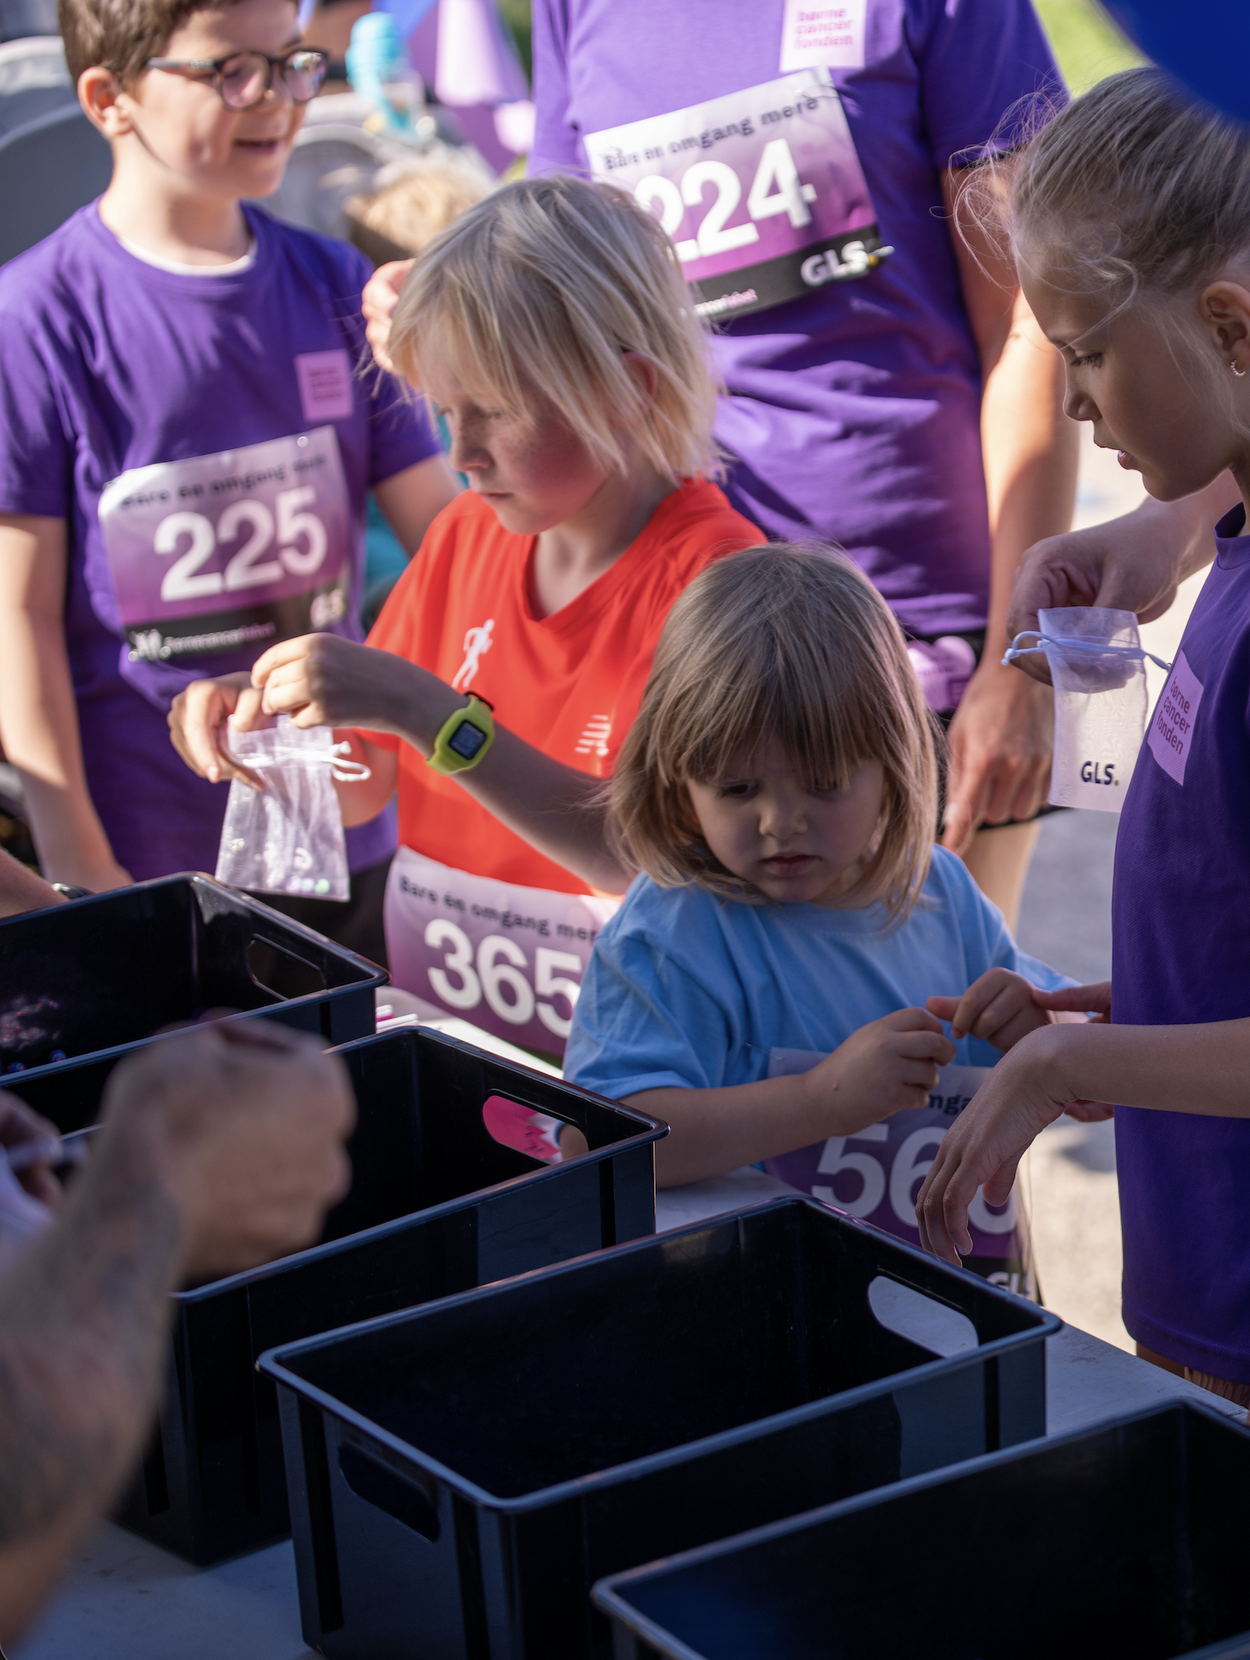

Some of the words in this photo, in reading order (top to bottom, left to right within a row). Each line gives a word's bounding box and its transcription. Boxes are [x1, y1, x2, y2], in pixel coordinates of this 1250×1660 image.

[670, 116, 755, 150] omgang
[761, 97, 819, 126] mere
[633, 137, 818, 263] 224
[153, 485, 328, 603] 225
[1157, 710, 1184, 755] fonden
[1163, 695, 1191, 735] cancer
[399, 875, 438, 903] Bare
[443, 892, 467, 913] én
[471, 903, 552, 937] omgang
[557, 921, 598, 942] mer
[424, 917, 583, 1040] 365
